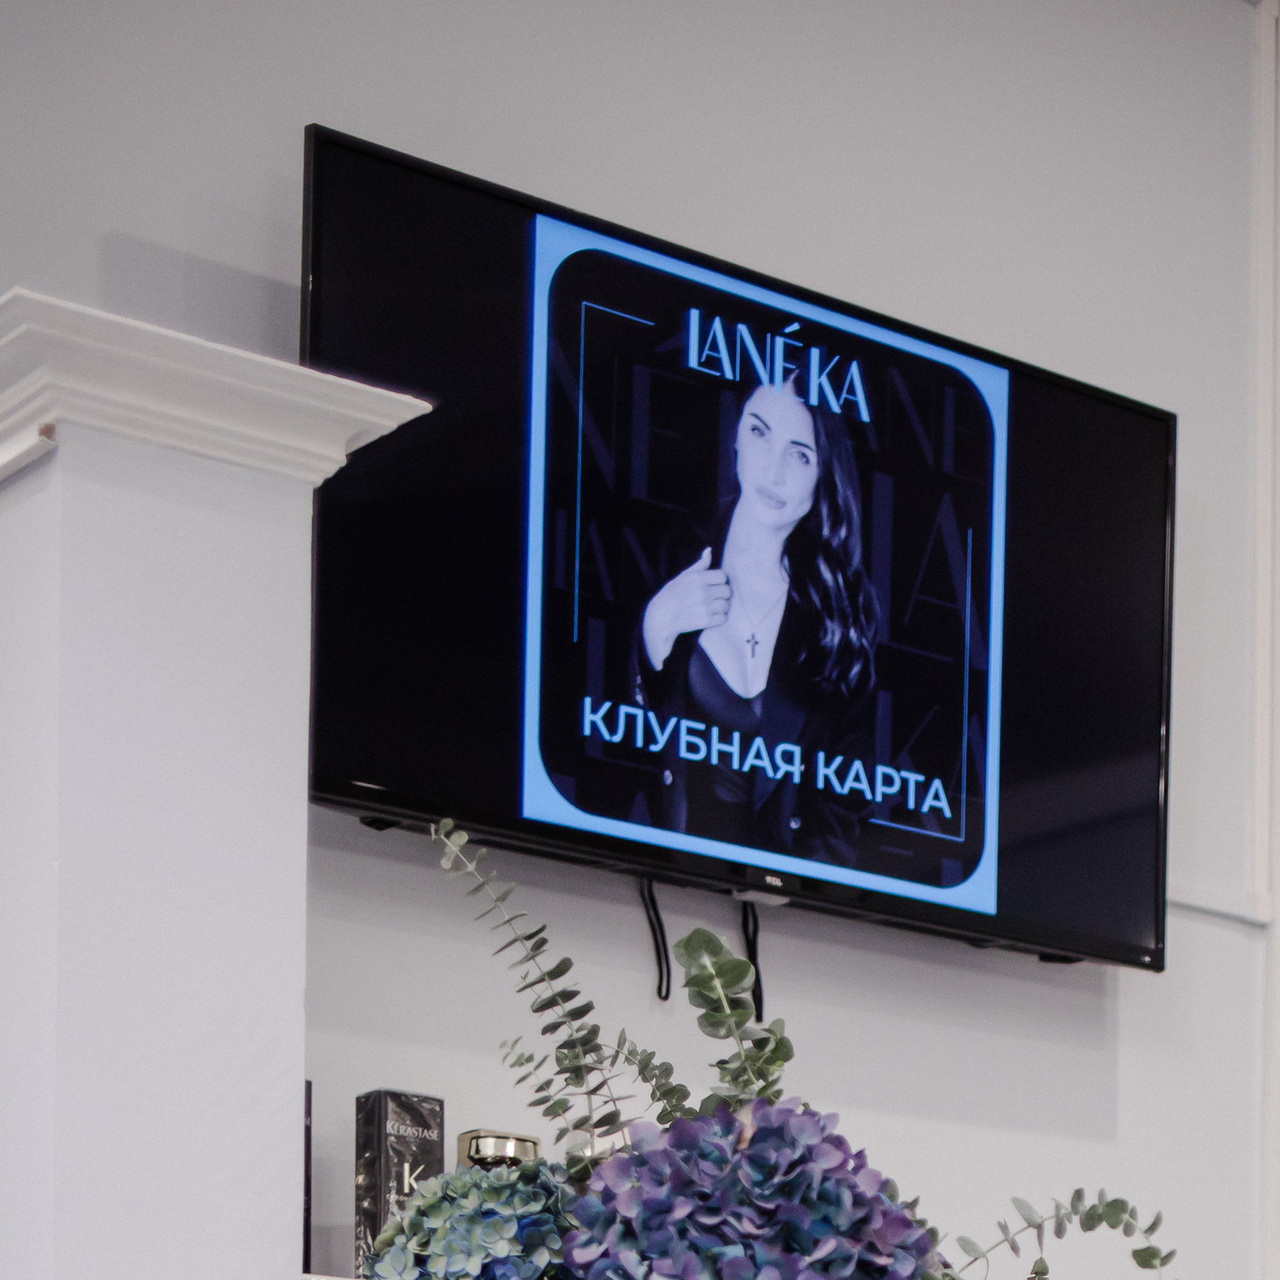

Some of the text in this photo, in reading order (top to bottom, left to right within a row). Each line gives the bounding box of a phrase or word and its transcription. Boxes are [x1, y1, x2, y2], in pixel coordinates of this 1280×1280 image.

[688, 307, 870, 423] LANÉKA
[583, 697, 952, 818] КЛУБНАЯ КАРТА
[403, 1162, 426, 1193] K
